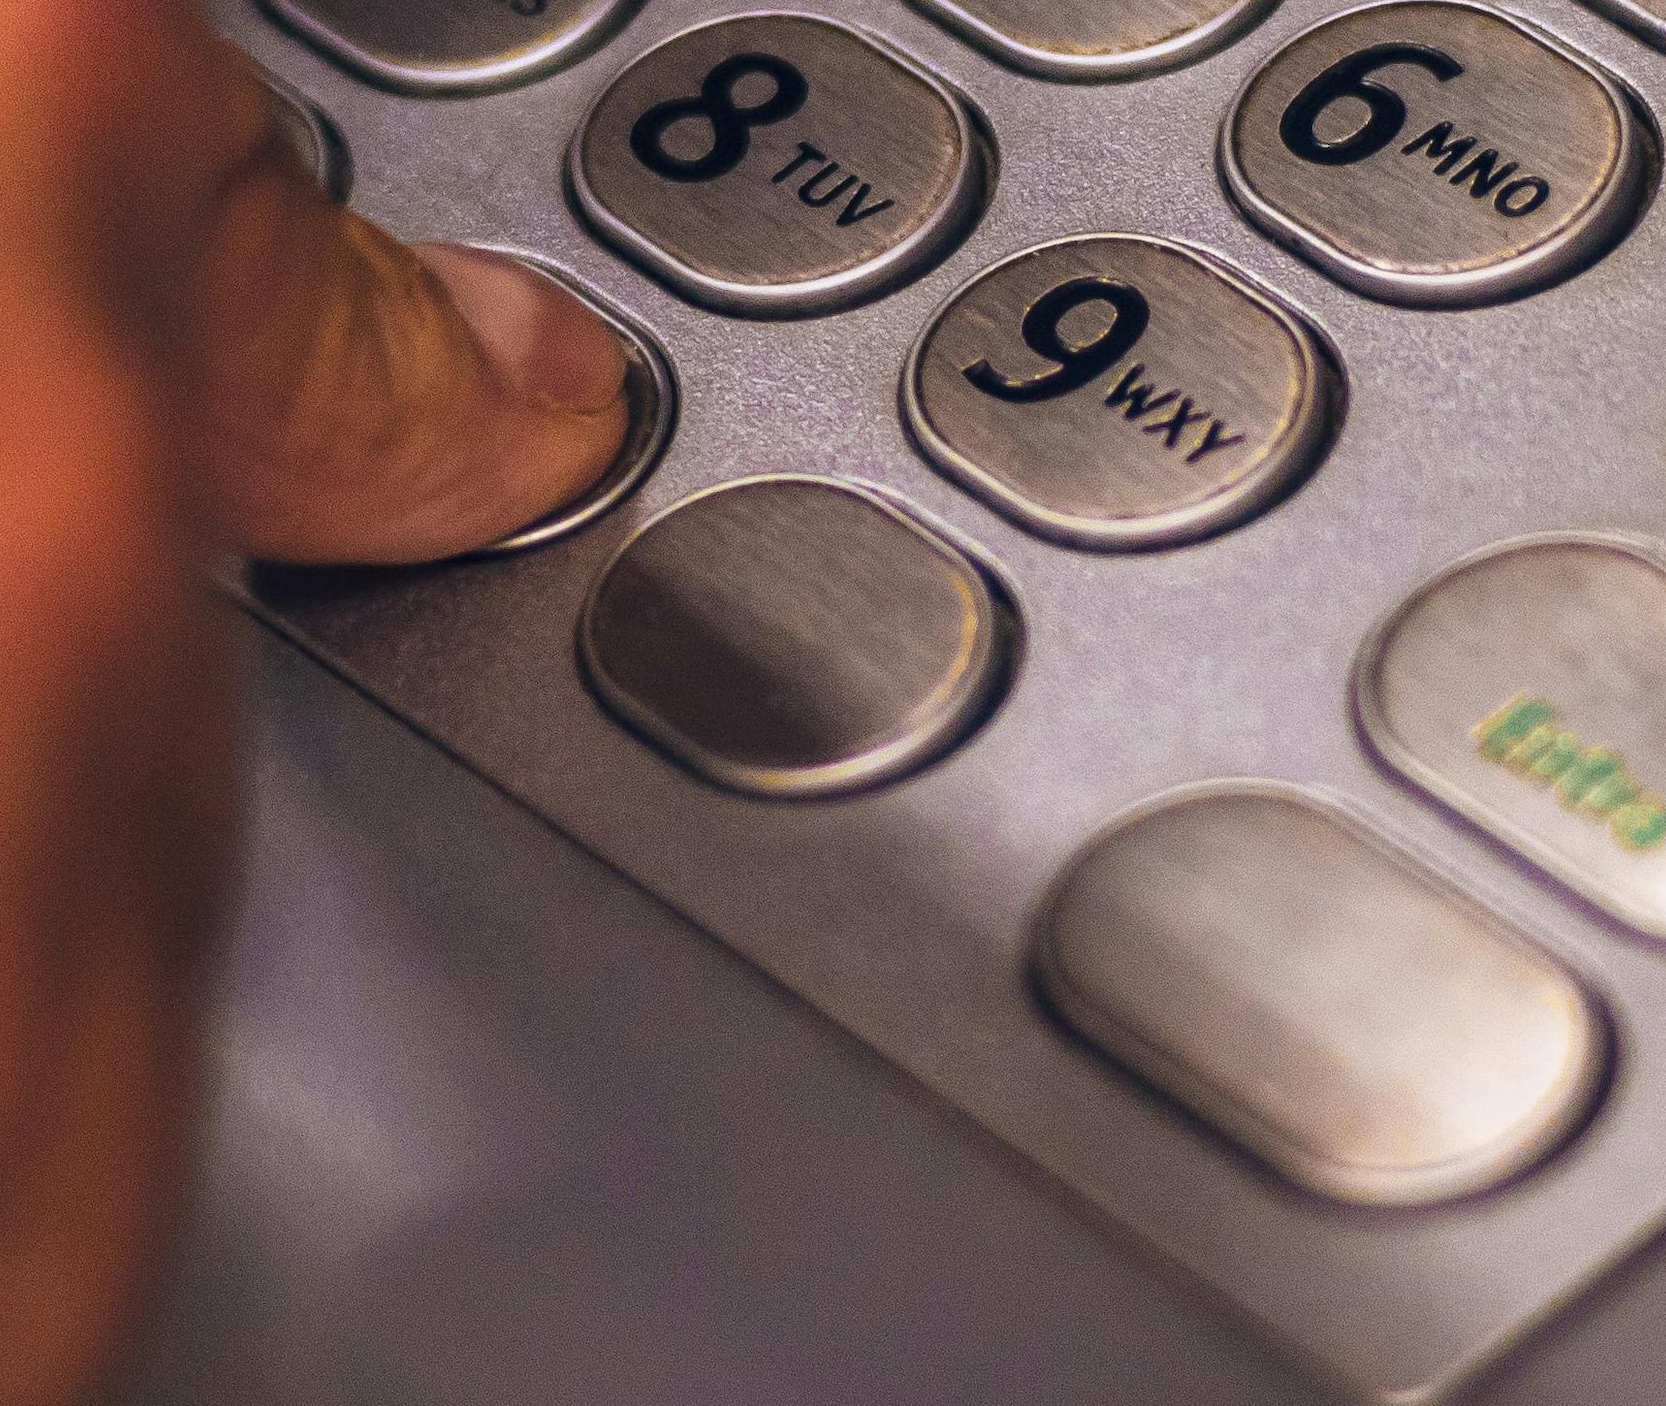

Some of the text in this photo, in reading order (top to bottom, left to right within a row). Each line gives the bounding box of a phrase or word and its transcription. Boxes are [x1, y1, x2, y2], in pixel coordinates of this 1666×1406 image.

[629, 52, 893, 226] 8 TUV
[1278, 40, 1551, 217] 6 MNO
[962, 276, 1245, 463] 9 WXY
